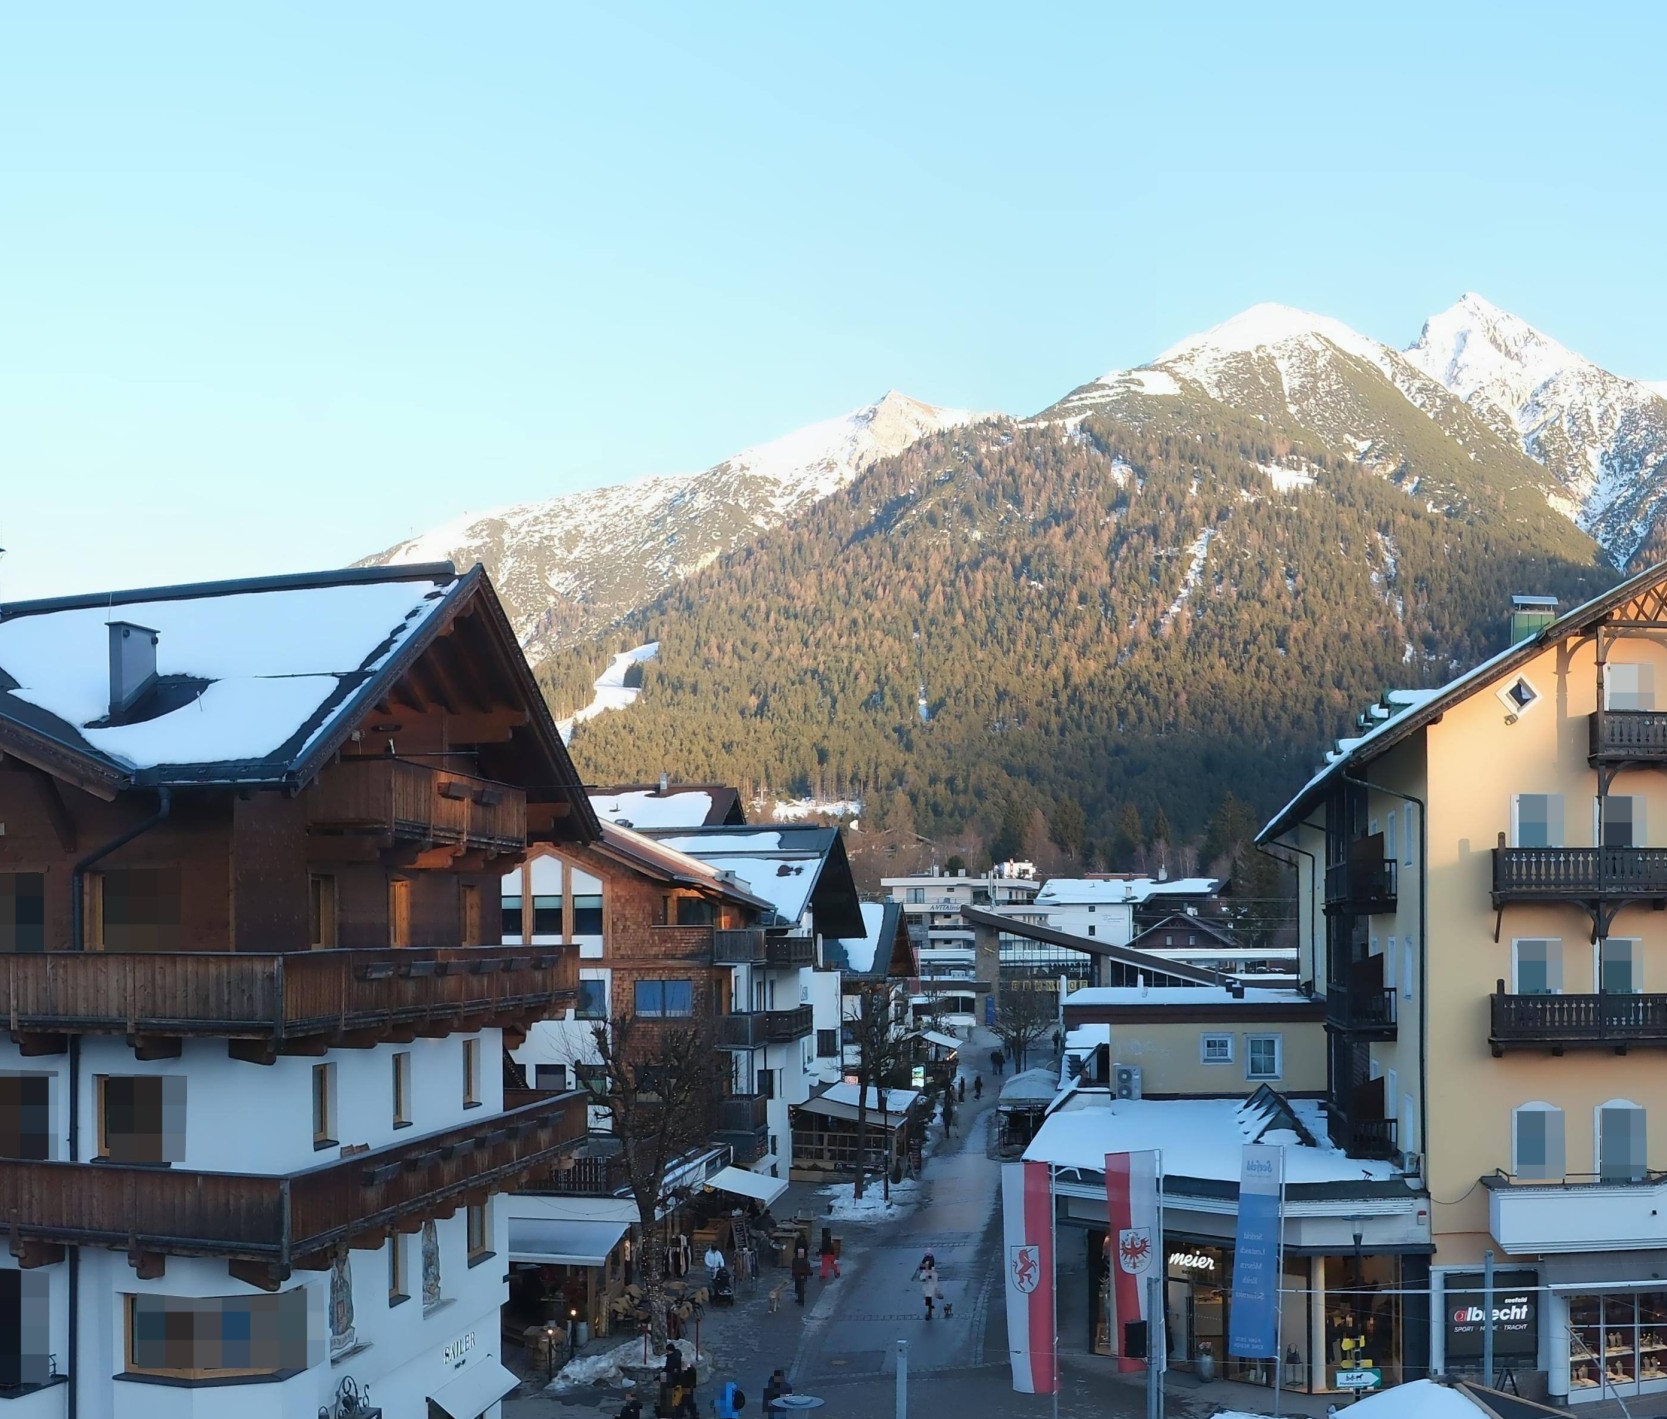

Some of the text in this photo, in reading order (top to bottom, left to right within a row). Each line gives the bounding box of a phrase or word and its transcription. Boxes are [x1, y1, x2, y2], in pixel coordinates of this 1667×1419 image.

[1169, 1250, 1215, 1270] meier
[1503, 1323, 1528, 1331] TRACHT
[443, 1331, 476, 1365] SAILER
